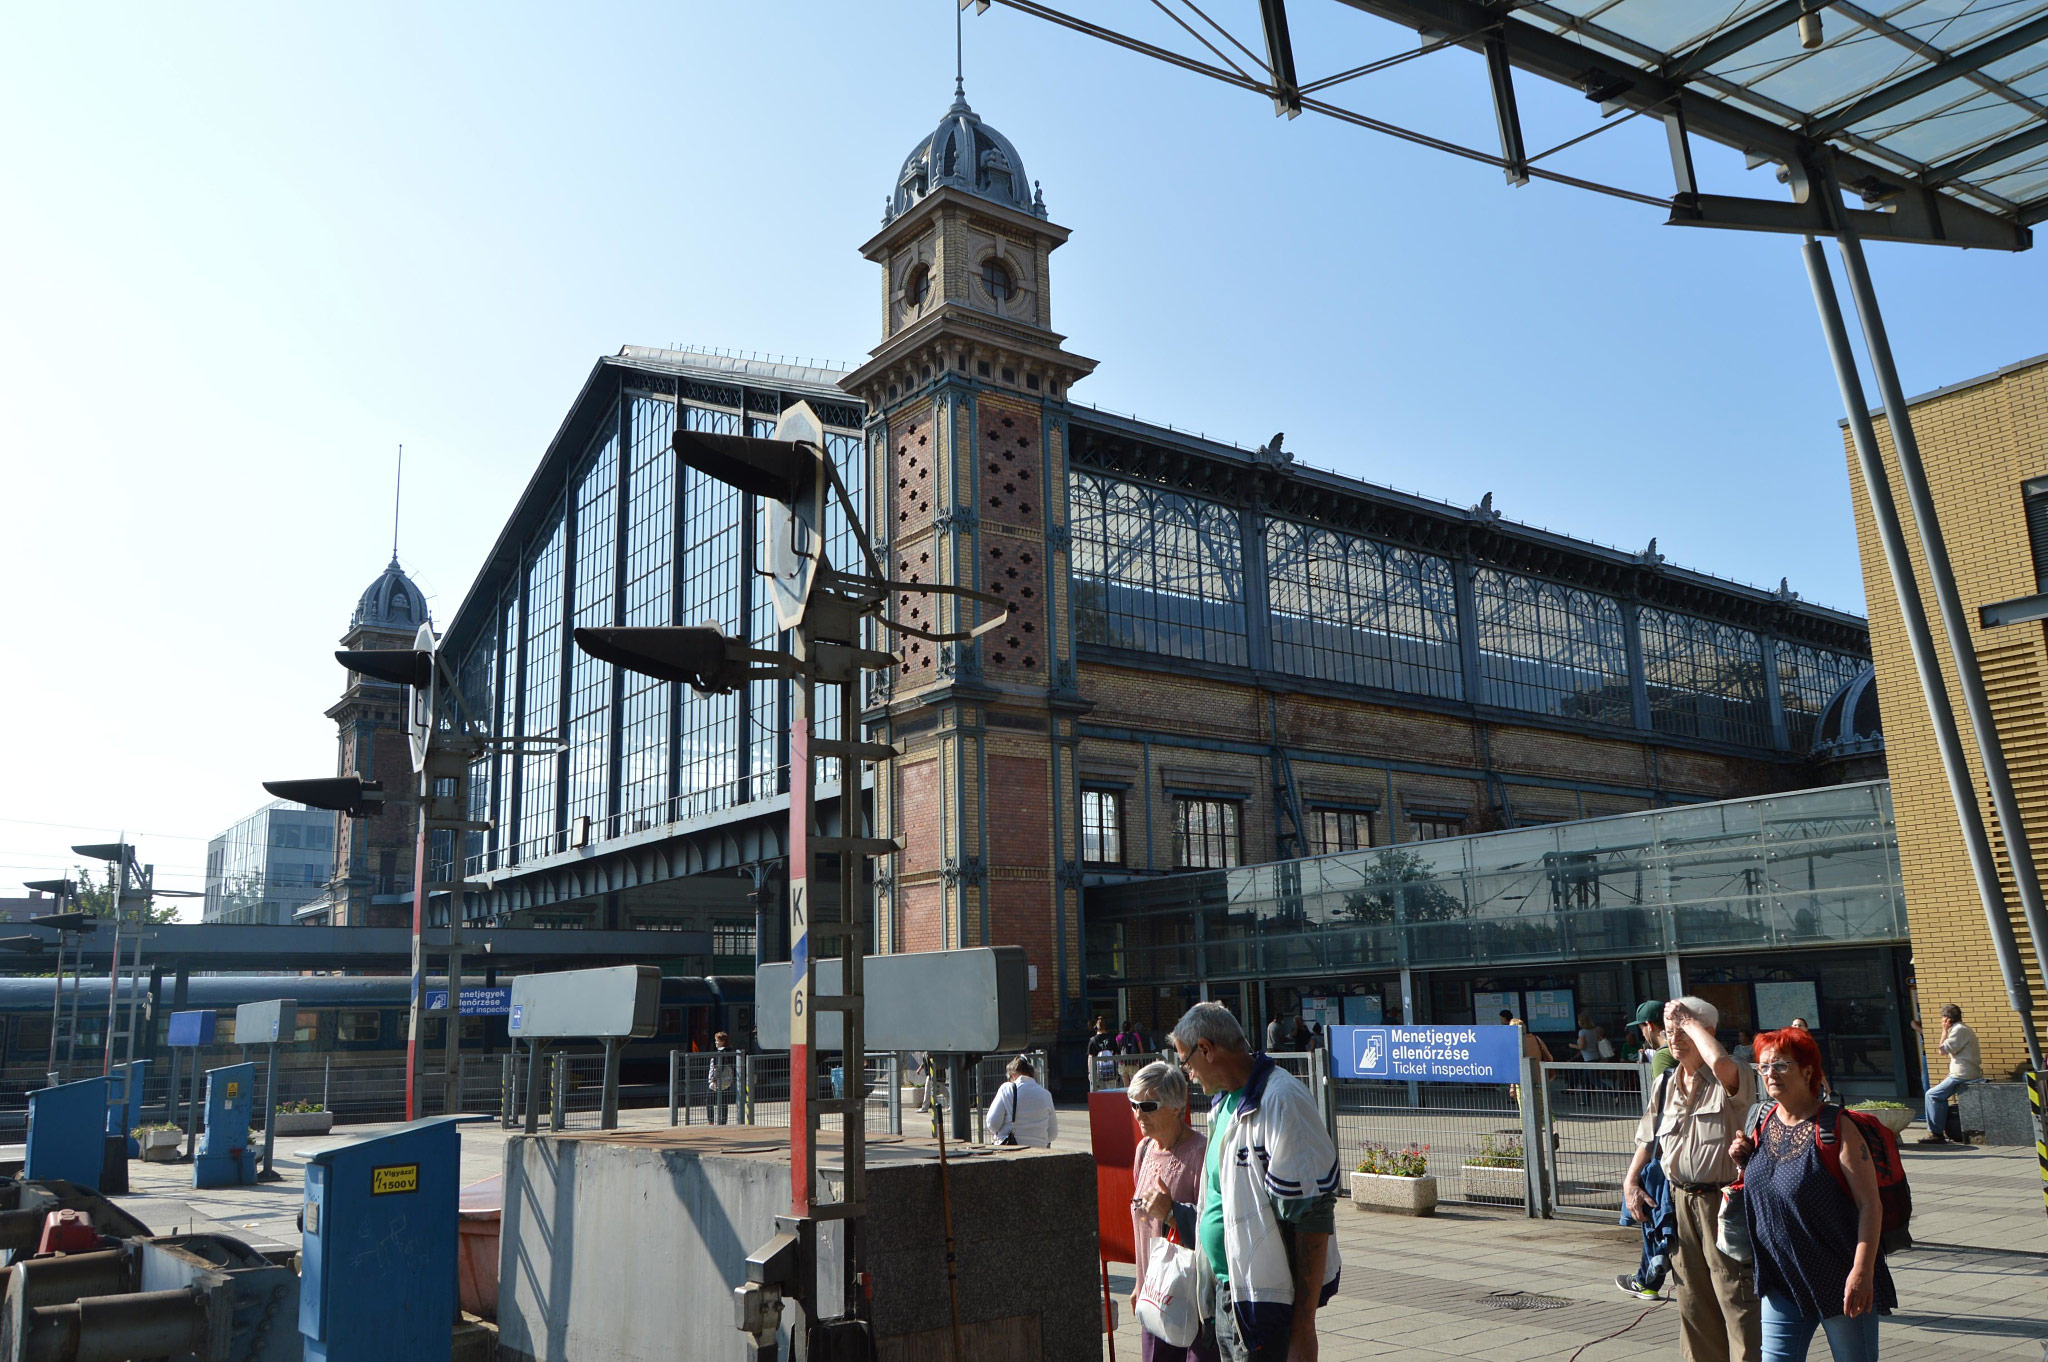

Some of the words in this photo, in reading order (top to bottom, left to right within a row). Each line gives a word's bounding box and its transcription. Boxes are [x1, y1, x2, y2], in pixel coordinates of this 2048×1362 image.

[792, 886, 804, 927] K
[412, 940, 419, 965] K
[459, 990, 506, 999] enetjegyek
[794, 990, 803, 1017] 6
[1391, 1029, 1477, 1046] Menetjegyek
[1392, 1045, 1470, 1060] ellenőrzése
[1392, 1062, 1427, 1075] Ticket
[1431, 1062, 1493, 1078] inspection
[382, 1180, 407, 1190] 1500
[408, 1179, 415, 1187] V
